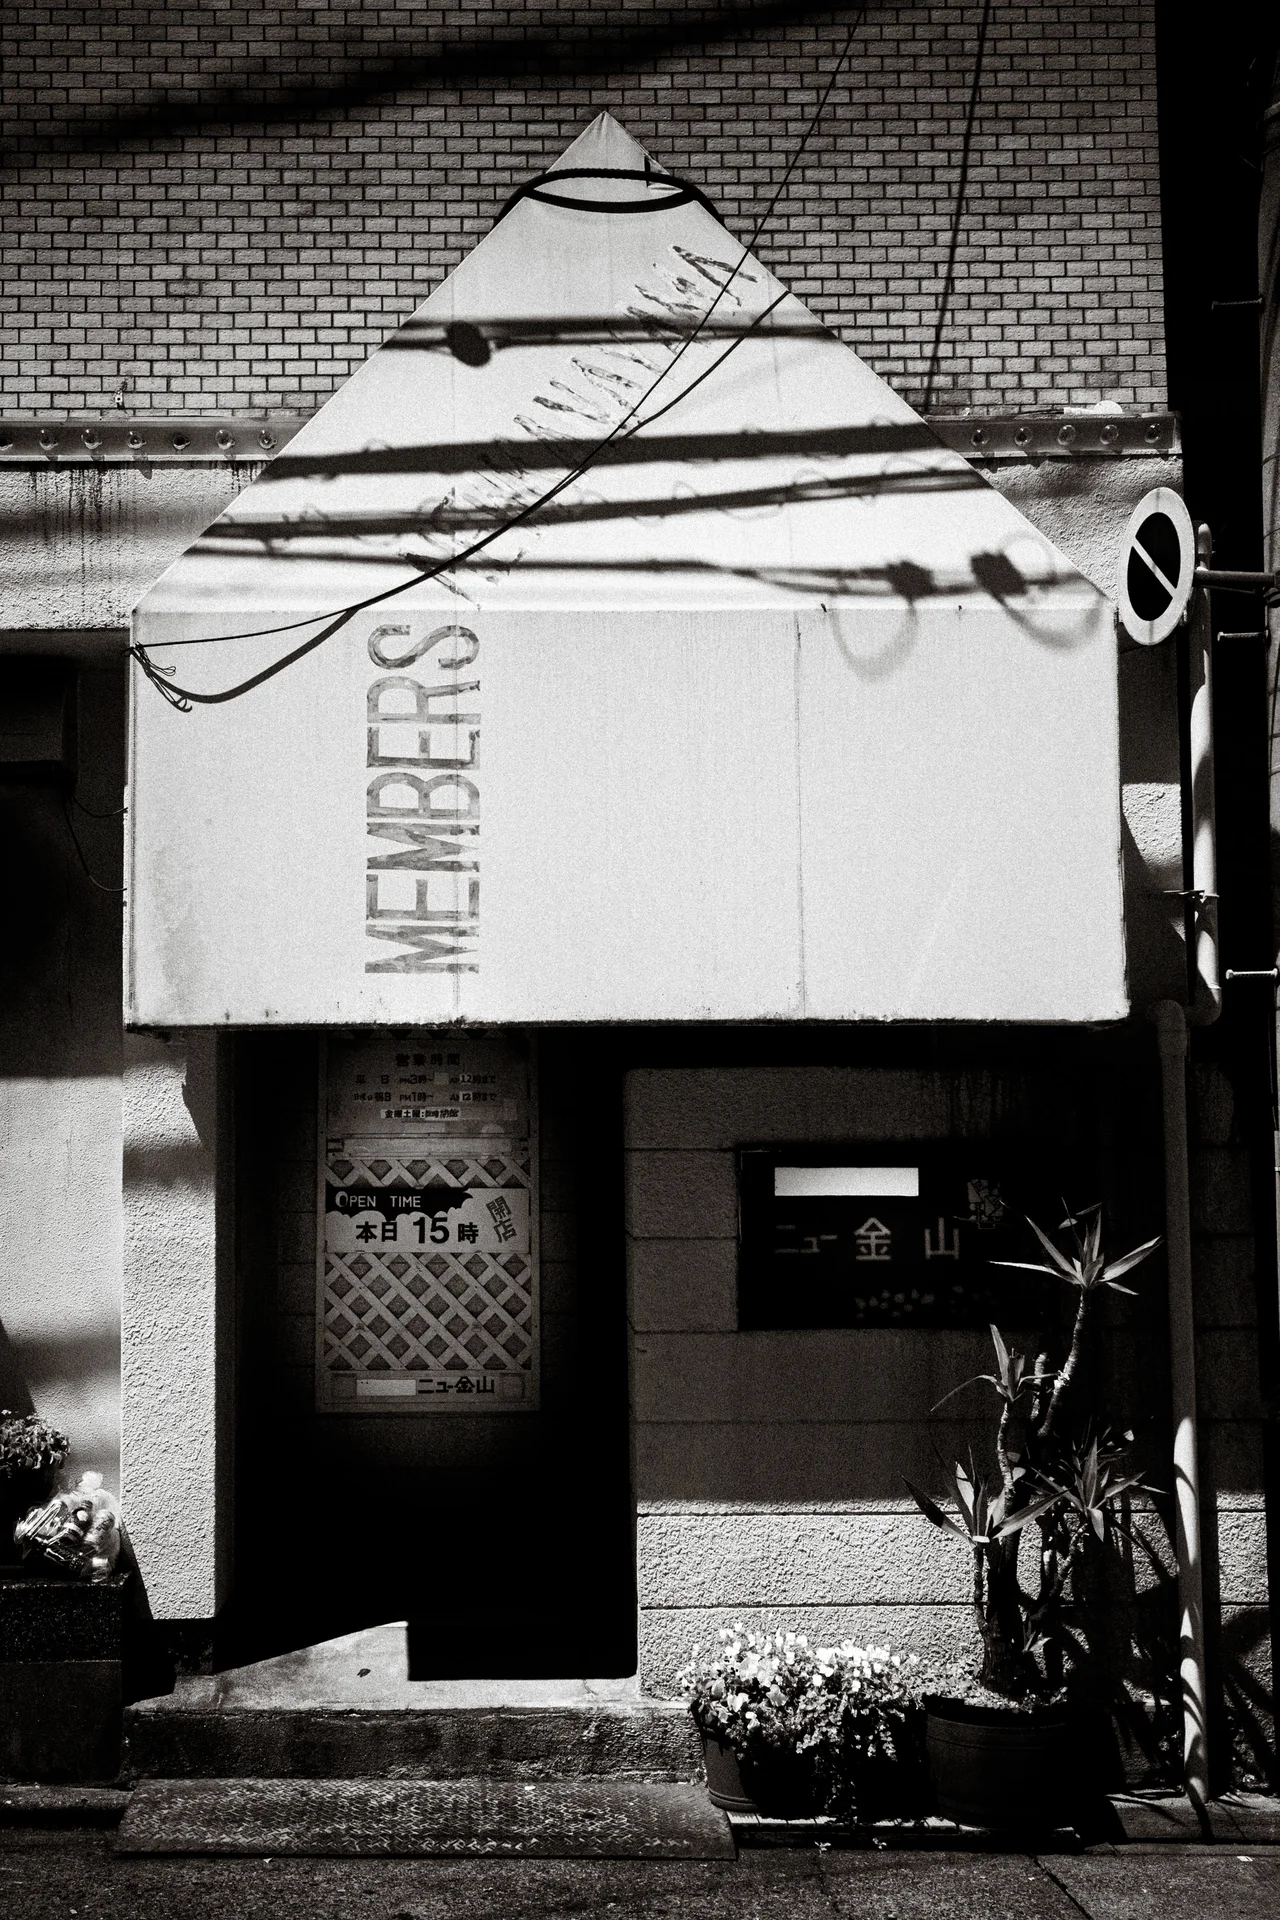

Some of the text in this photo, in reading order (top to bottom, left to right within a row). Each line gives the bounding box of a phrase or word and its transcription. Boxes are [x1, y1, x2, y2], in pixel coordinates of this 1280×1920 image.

[365, 624, 481, 974] MEMBERS
[395, 1053, 461, 1067] 営業時間
[335, 1190, 422, 1208] OPEN TIME
[417, 1376, 496, 1394] ニュー金山
